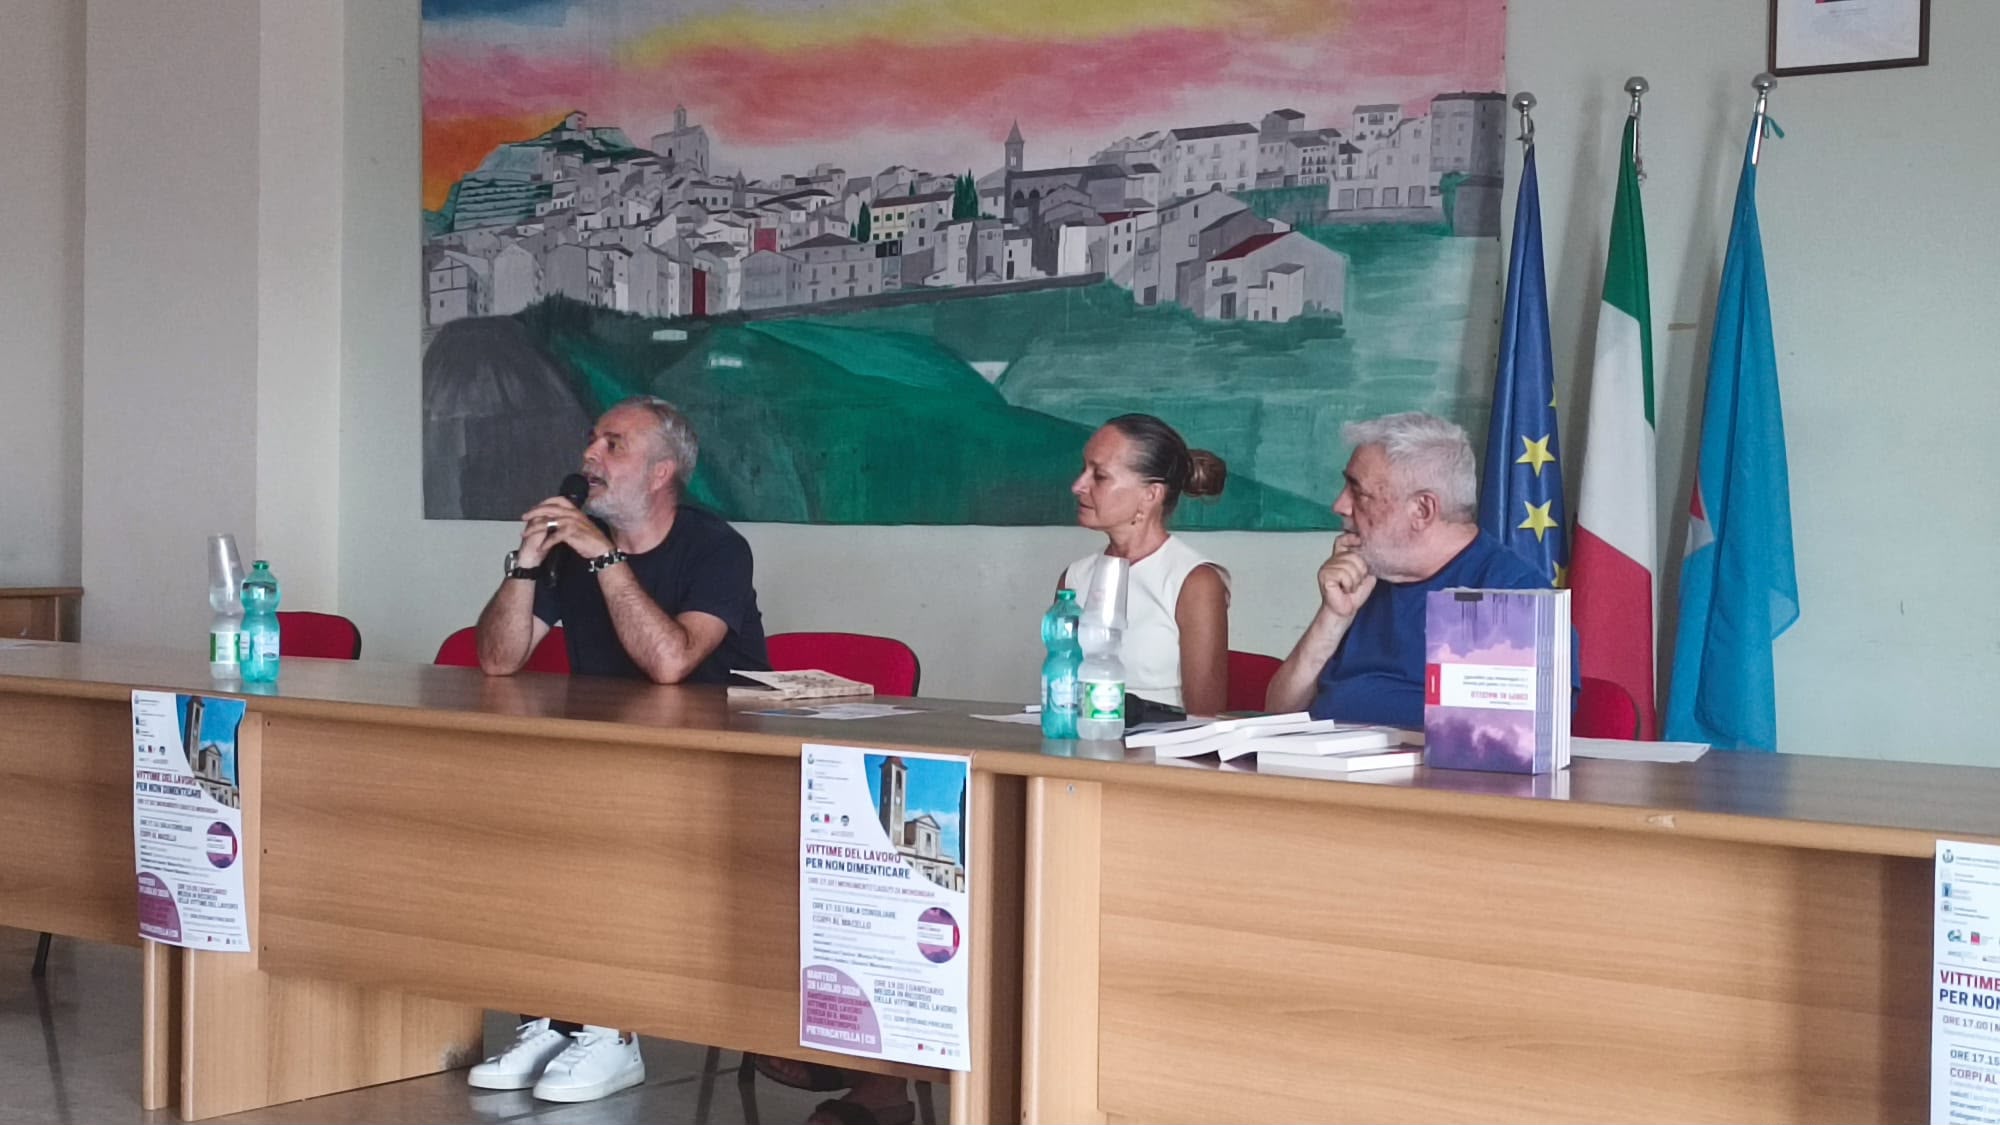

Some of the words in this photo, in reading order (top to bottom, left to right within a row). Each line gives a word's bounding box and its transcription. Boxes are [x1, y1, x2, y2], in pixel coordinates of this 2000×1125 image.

[136, 770, 160, 782] VITTIME
[136, 781, 148, 792] PER
[806, 844, 843, 858] VITTIME
[845, 847, 862, 860] DEL
[864, 850, 901, 863] LAVORO
[805, 857, 823, 869] PER
[825, 859, 845, 872] NON
[846, 862, 911, 879] DIMENTICARE
[1940, 969, 2000, 992] VITTIME
[1939, 988, 1969, 1006] PER
[1942, 1014, 1961, 1026] ORE
[1950, 1048, 1970, 1061] ORE
[1950, 1067, 1982, 1083] CORPI
[1983, 1073, 1998, 1086] AL
